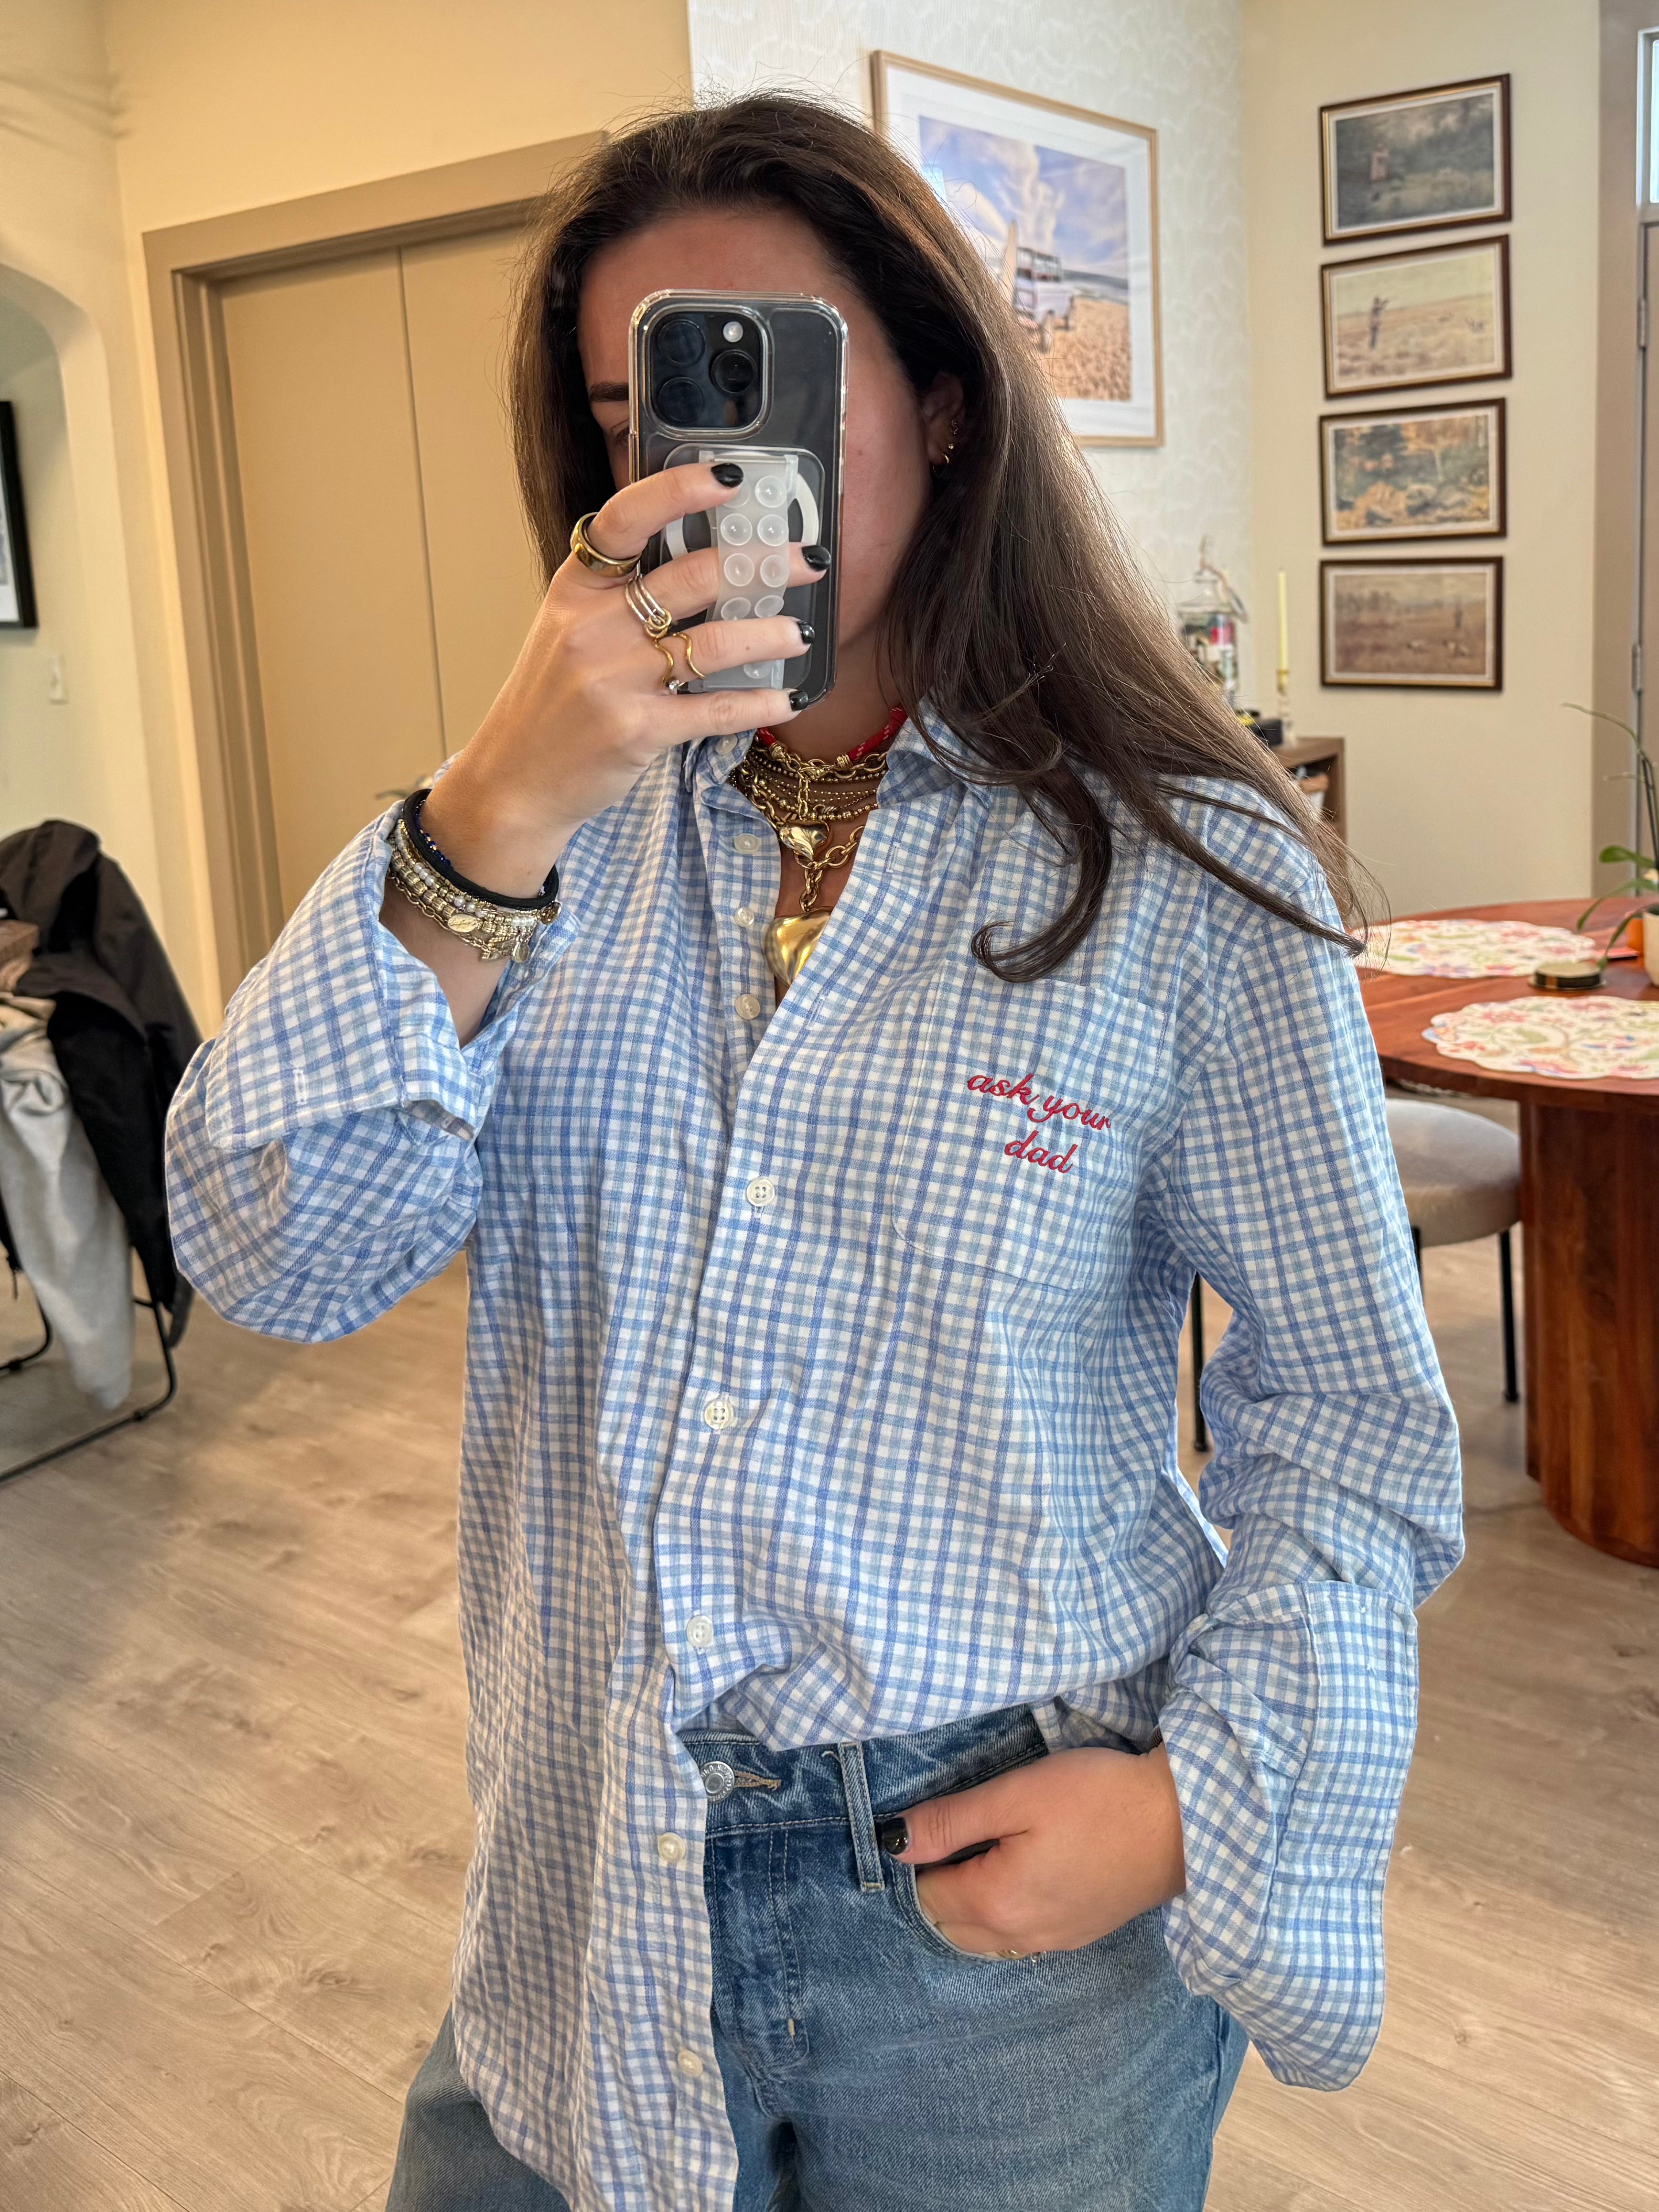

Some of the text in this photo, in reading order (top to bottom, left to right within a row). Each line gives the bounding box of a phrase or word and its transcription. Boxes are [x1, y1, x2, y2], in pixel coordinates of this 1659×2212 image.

[967, 1073, 1111, 1130] ask your
[1004, 1130, 1078, 1174] dad
